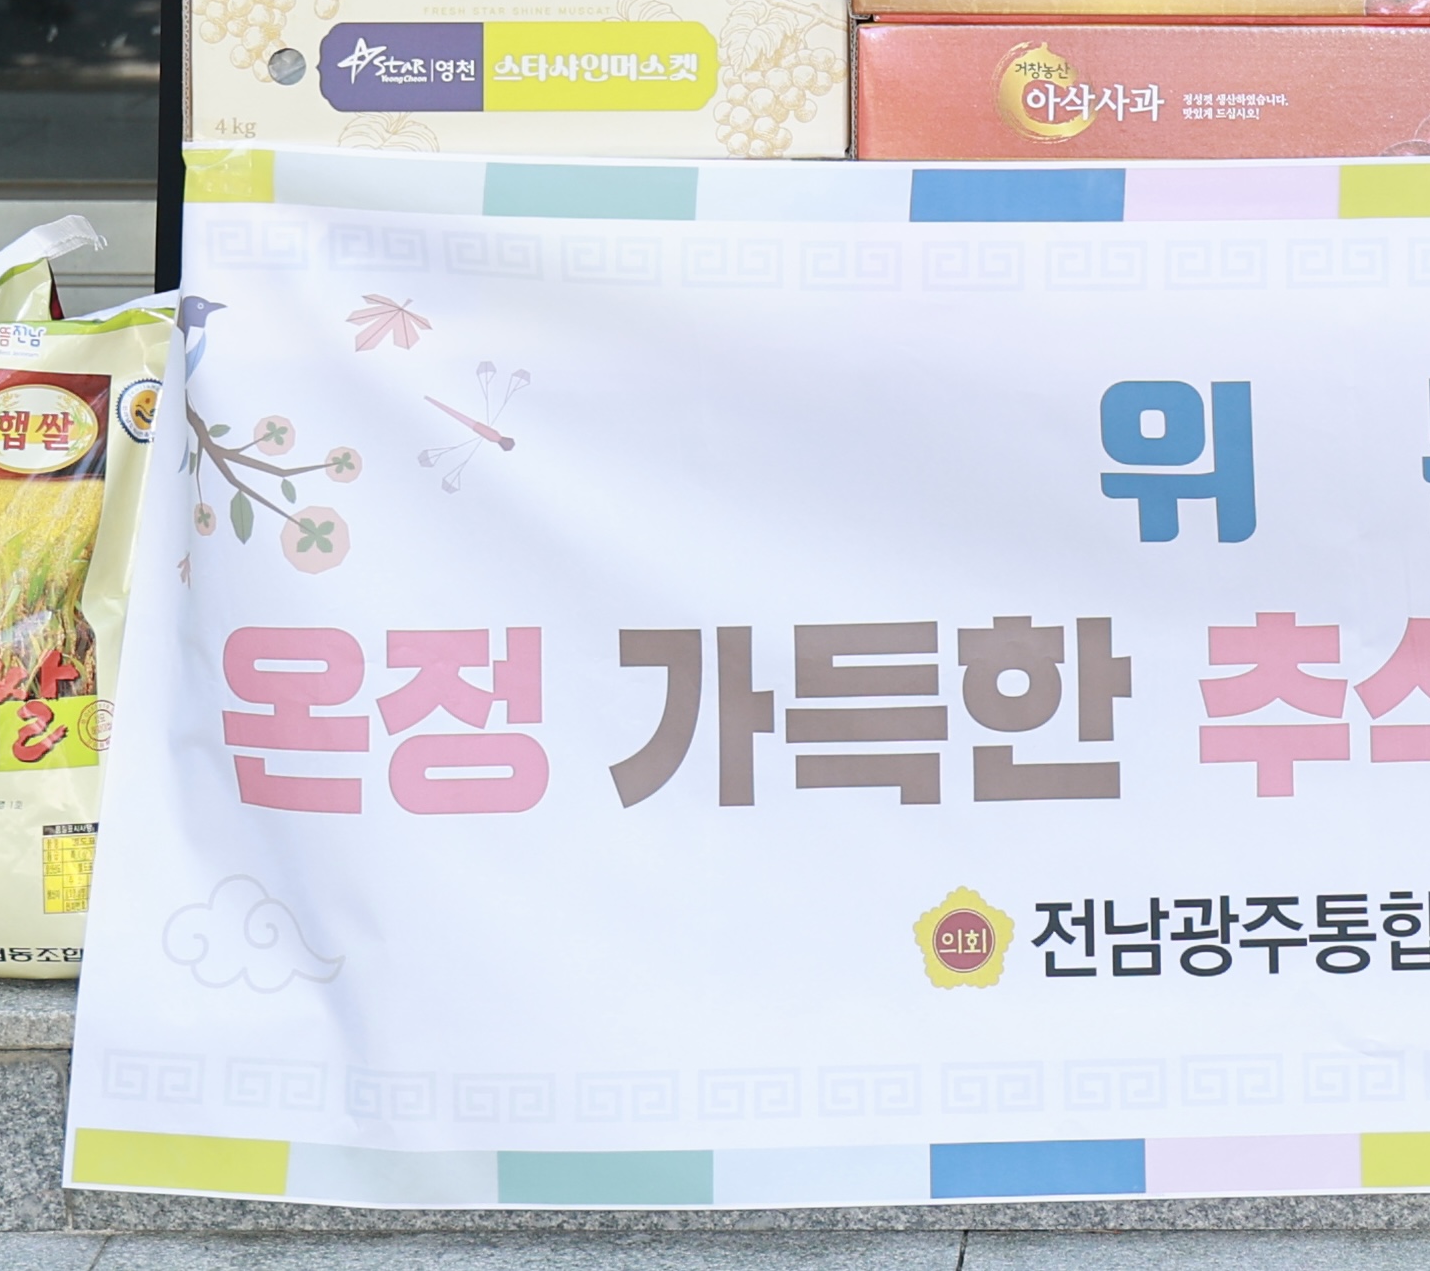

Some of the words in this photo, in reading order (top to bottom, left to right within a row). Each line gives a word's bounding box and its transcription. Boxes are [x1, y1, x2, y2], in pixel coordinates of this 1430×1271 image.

[424, 6, 466, 16] FRESH
[473, 6, 507, 16] STAR
[512, 6, 553, 16] SHINE
[559, 6, 612, 16] MUSCAT
[435, 59, 476, 83] 영천
[492, 53, 699, 84] 스타샤인머스켓
[1015, 62, 1071, 80] 거창농산
[1026, 83, 1165, 122] 아삭사과
[1216, 93, 1289, 107] 생산하였습니다.
[1182, 108, 1214, 120] 맛있게
[1216, 107, 1260, 120] 드십시오!
[214, 117, 226, 137] 4
[230, 116, 258, 140] kg
[1100, 380, 1257, 544] 위
[221, 624, 552, 818] 온정
[608, 613, 1133, 811] 가득한
[940, 926, 989, 959] 의회
